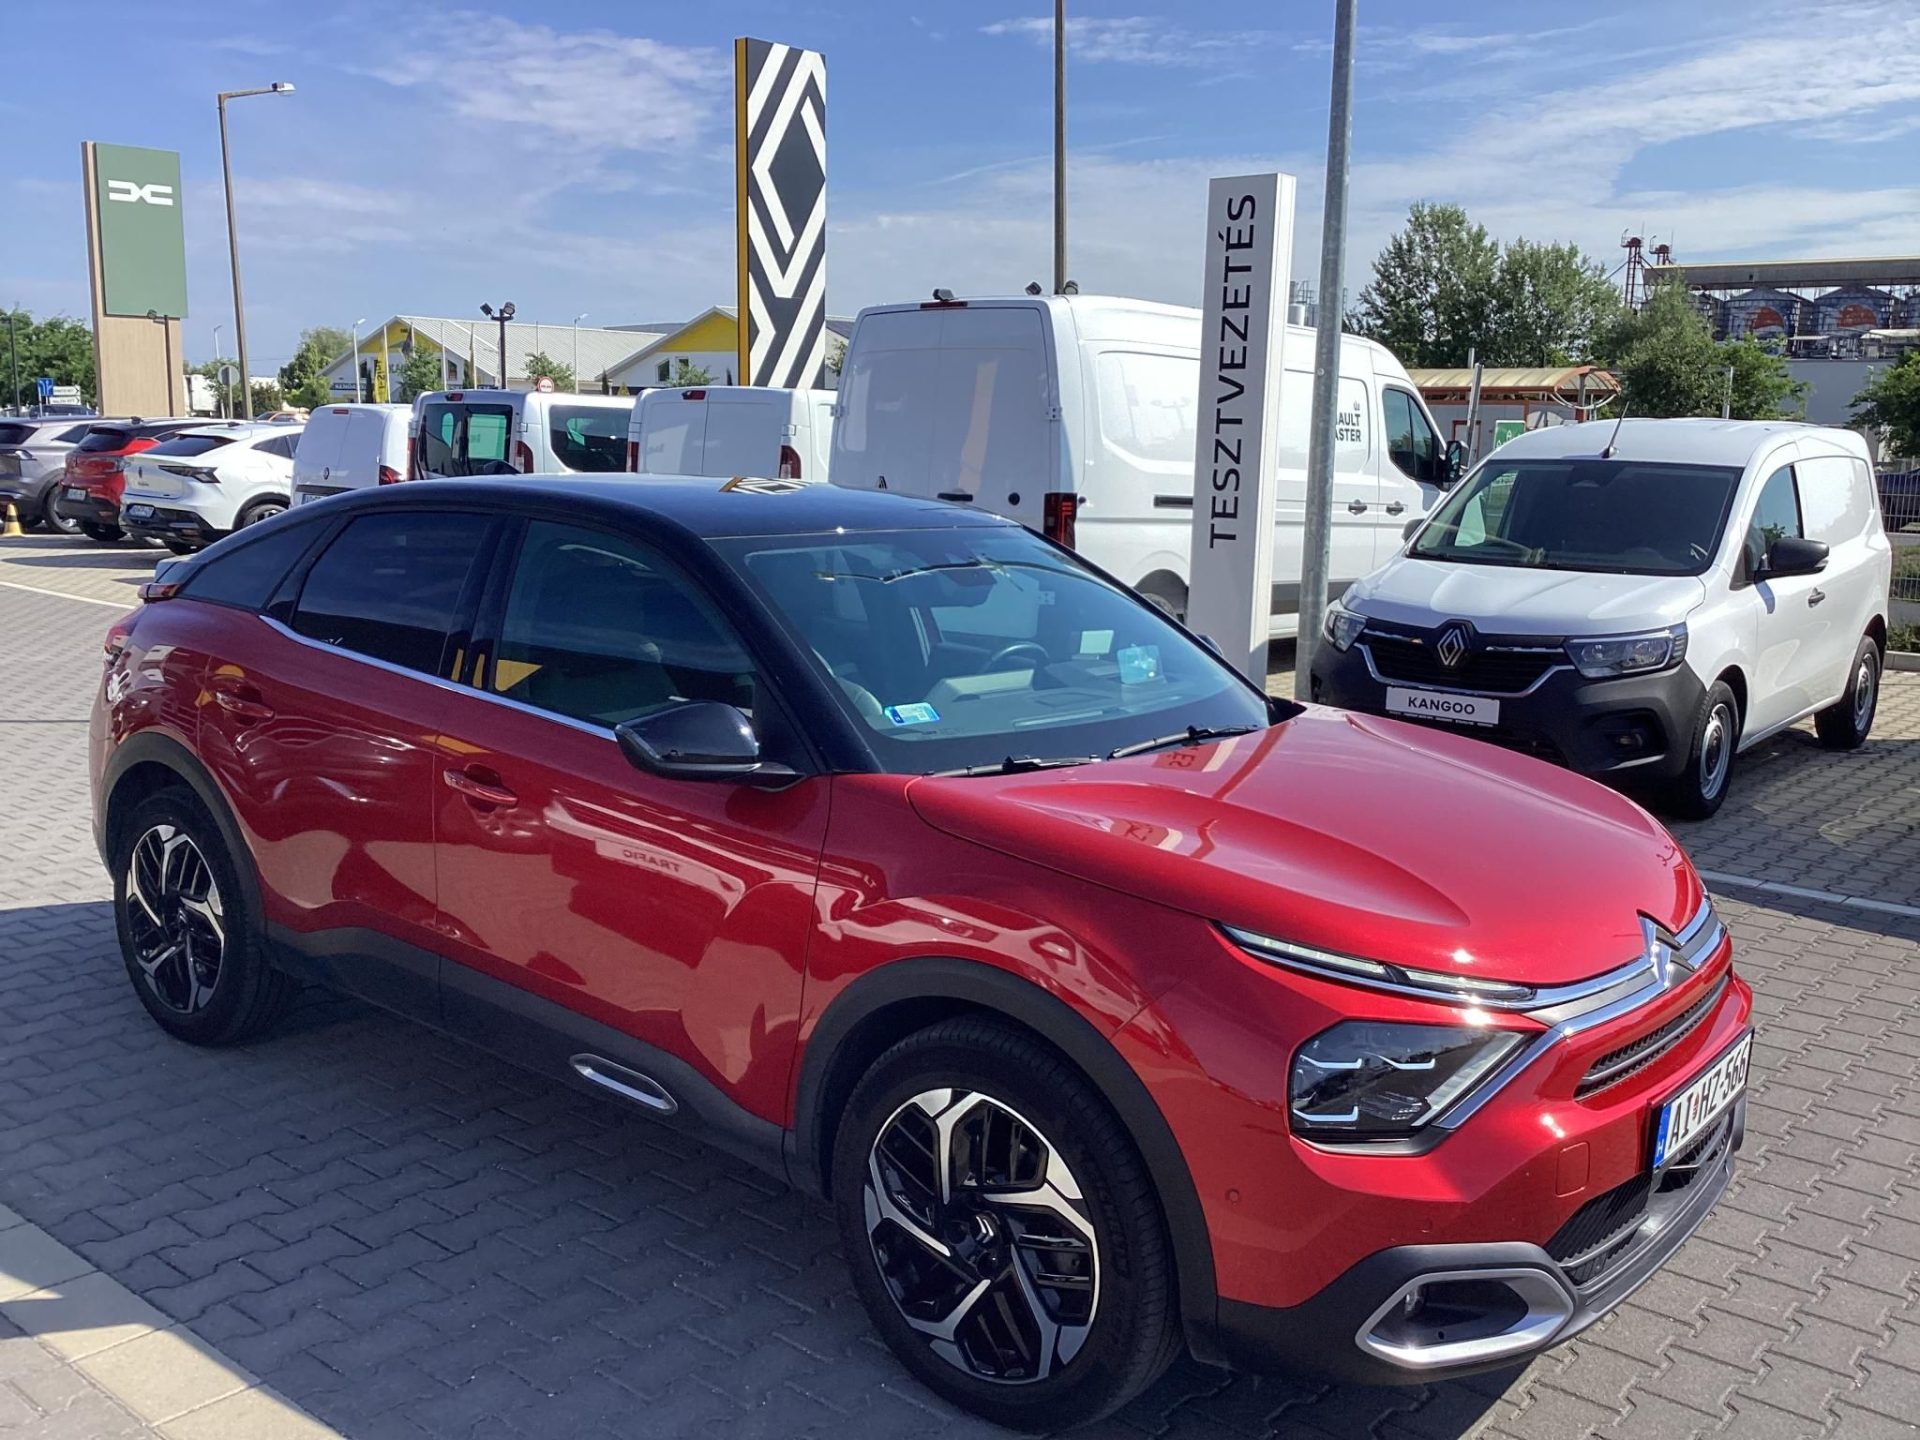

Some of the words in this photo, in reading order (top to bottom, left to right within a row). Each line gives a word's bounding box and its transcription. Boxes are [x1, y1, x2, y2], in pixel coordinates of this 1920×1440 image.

[1209, 194, 1256, 549] TESZTVEZETÉS
[1336, 412, 1361, 427] AULT
[1335, 428, 1361, 442] ASTER
[1408, 696, 1475, 715] KANGOO
